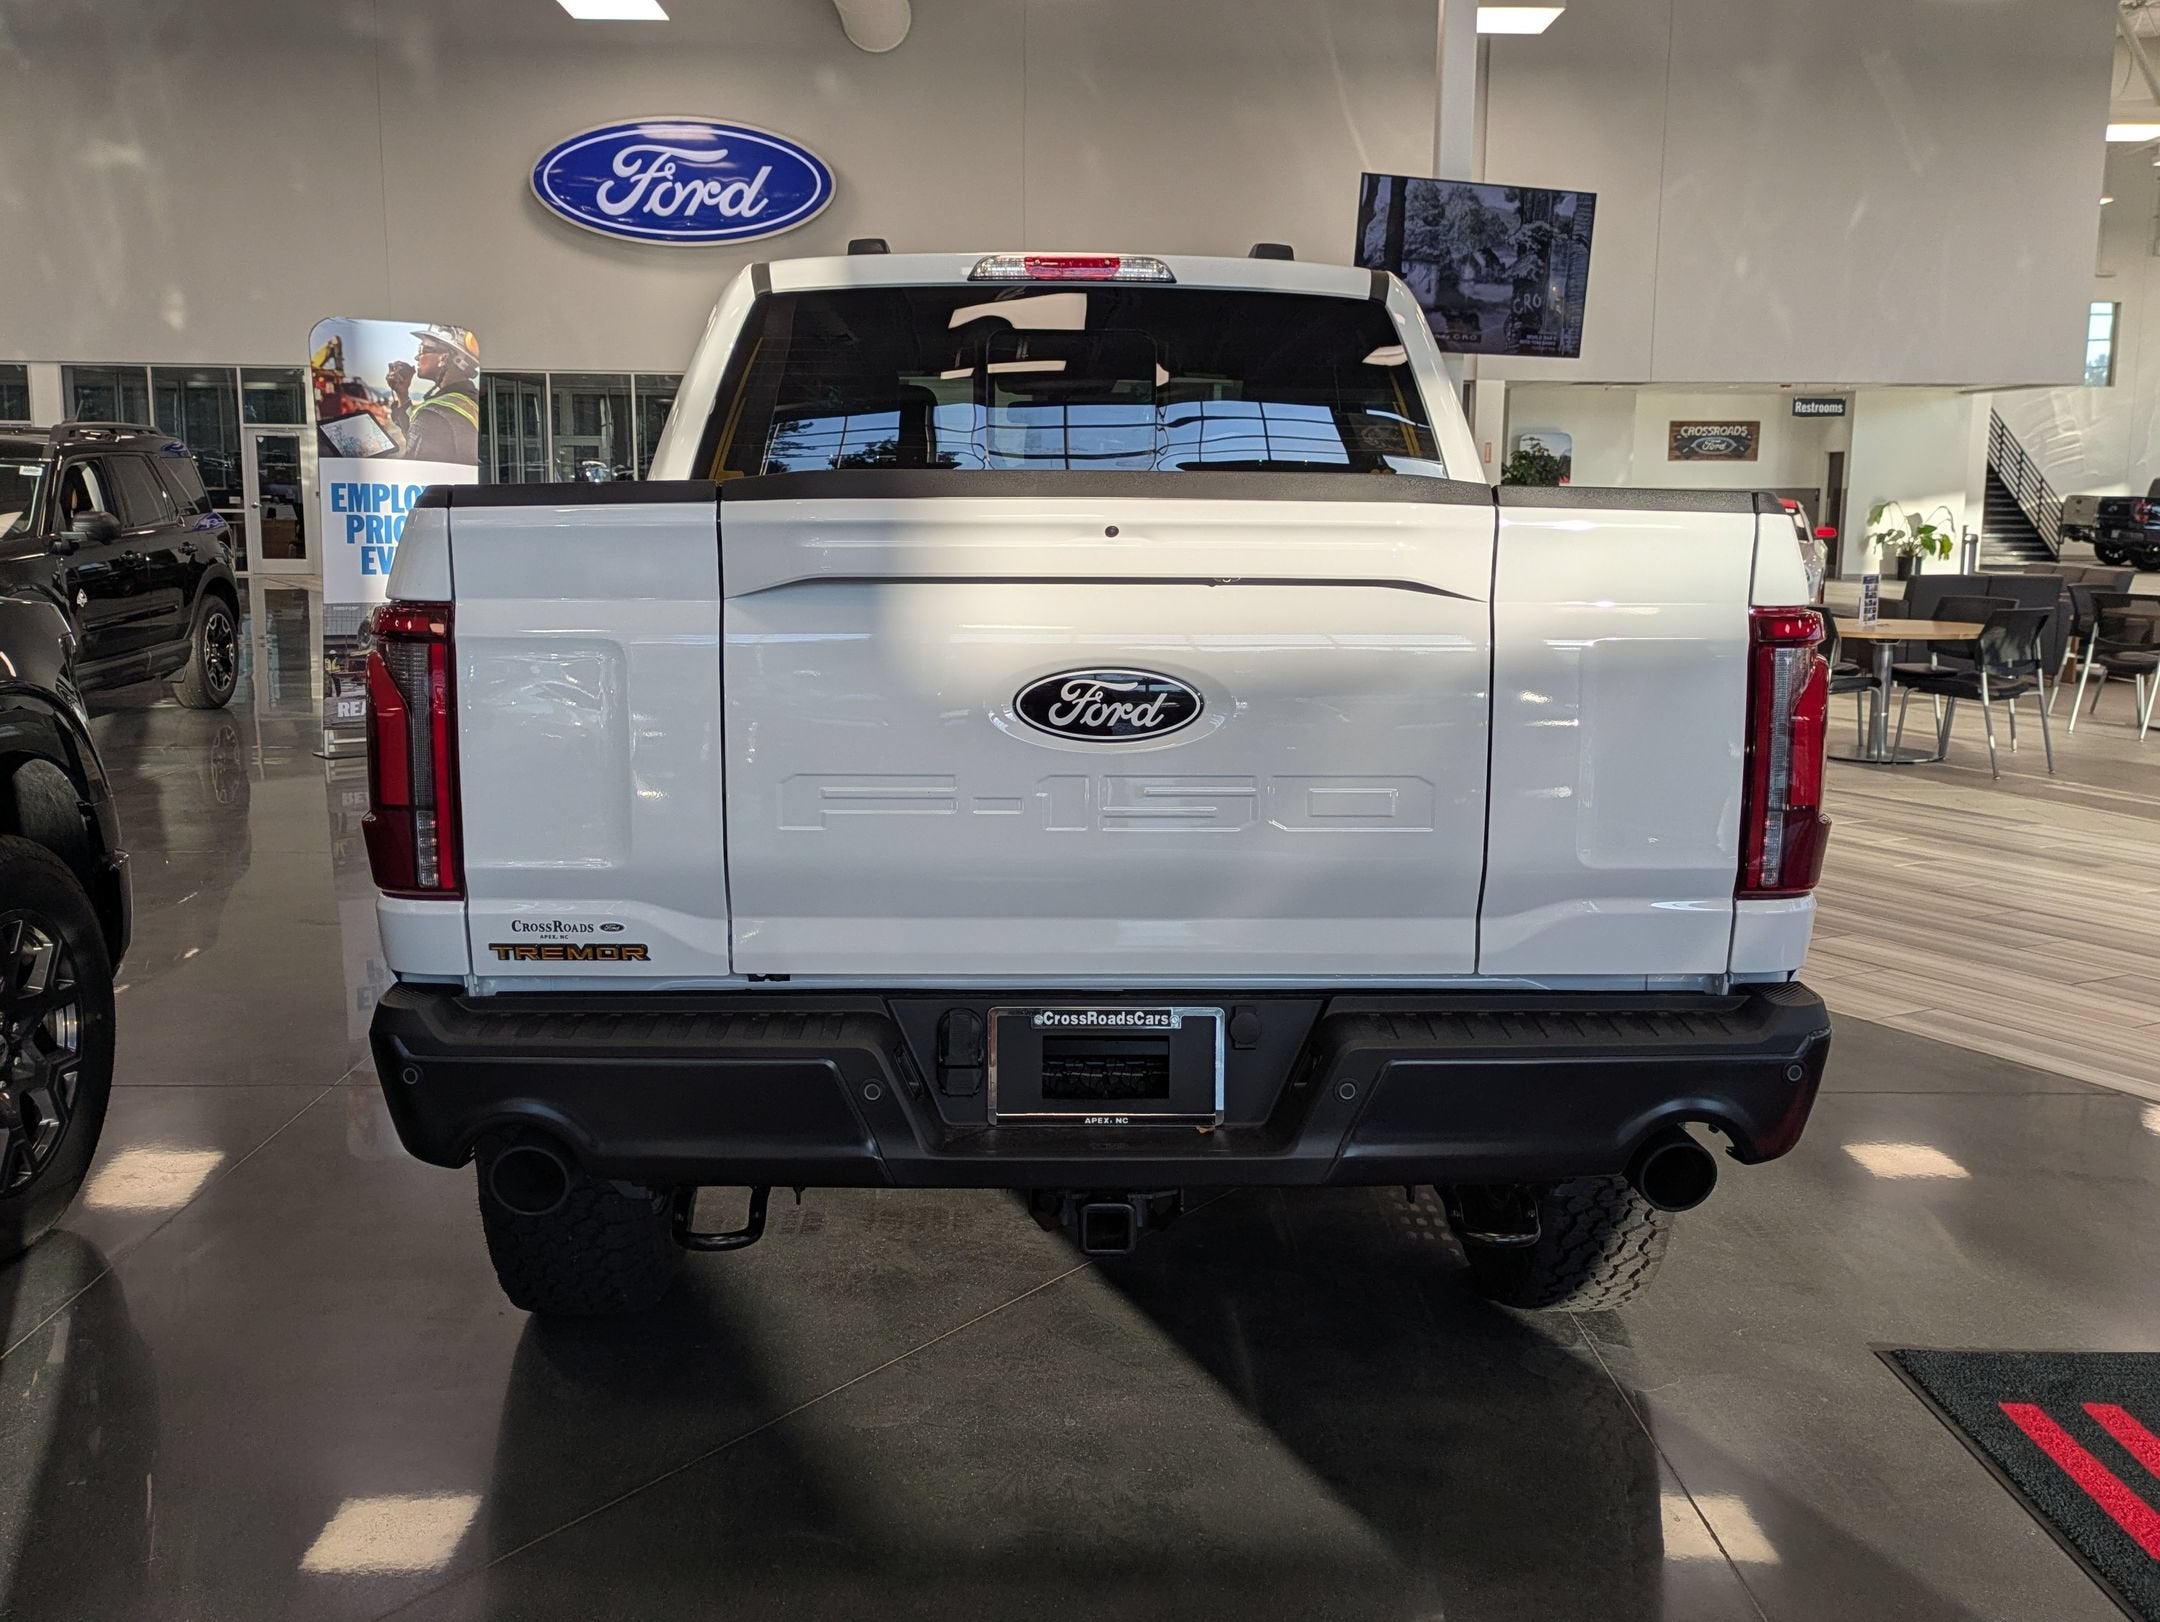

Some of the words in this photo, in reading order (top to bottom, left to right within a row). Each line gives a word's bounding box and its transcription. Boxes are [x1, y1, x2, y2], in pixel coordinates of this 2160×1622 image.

[596, 144, 773, 217] Ford
[1795, 401, 1843, 413] Restrooms
[1680, 426, 1748, 437] CROSSROADS
[1702, 439, 1728, 451] Ford
[361, 546, 397, 576] EV
[1048, 679, 1168, 727] Ford
[776, 774, 1436, 832] F-150
[488, 943, 652, 961] TREMOR
[1043, 1011, 1169, 1025] CrossRoadsCars
[1115, 1116, 1129, 1124] NC
